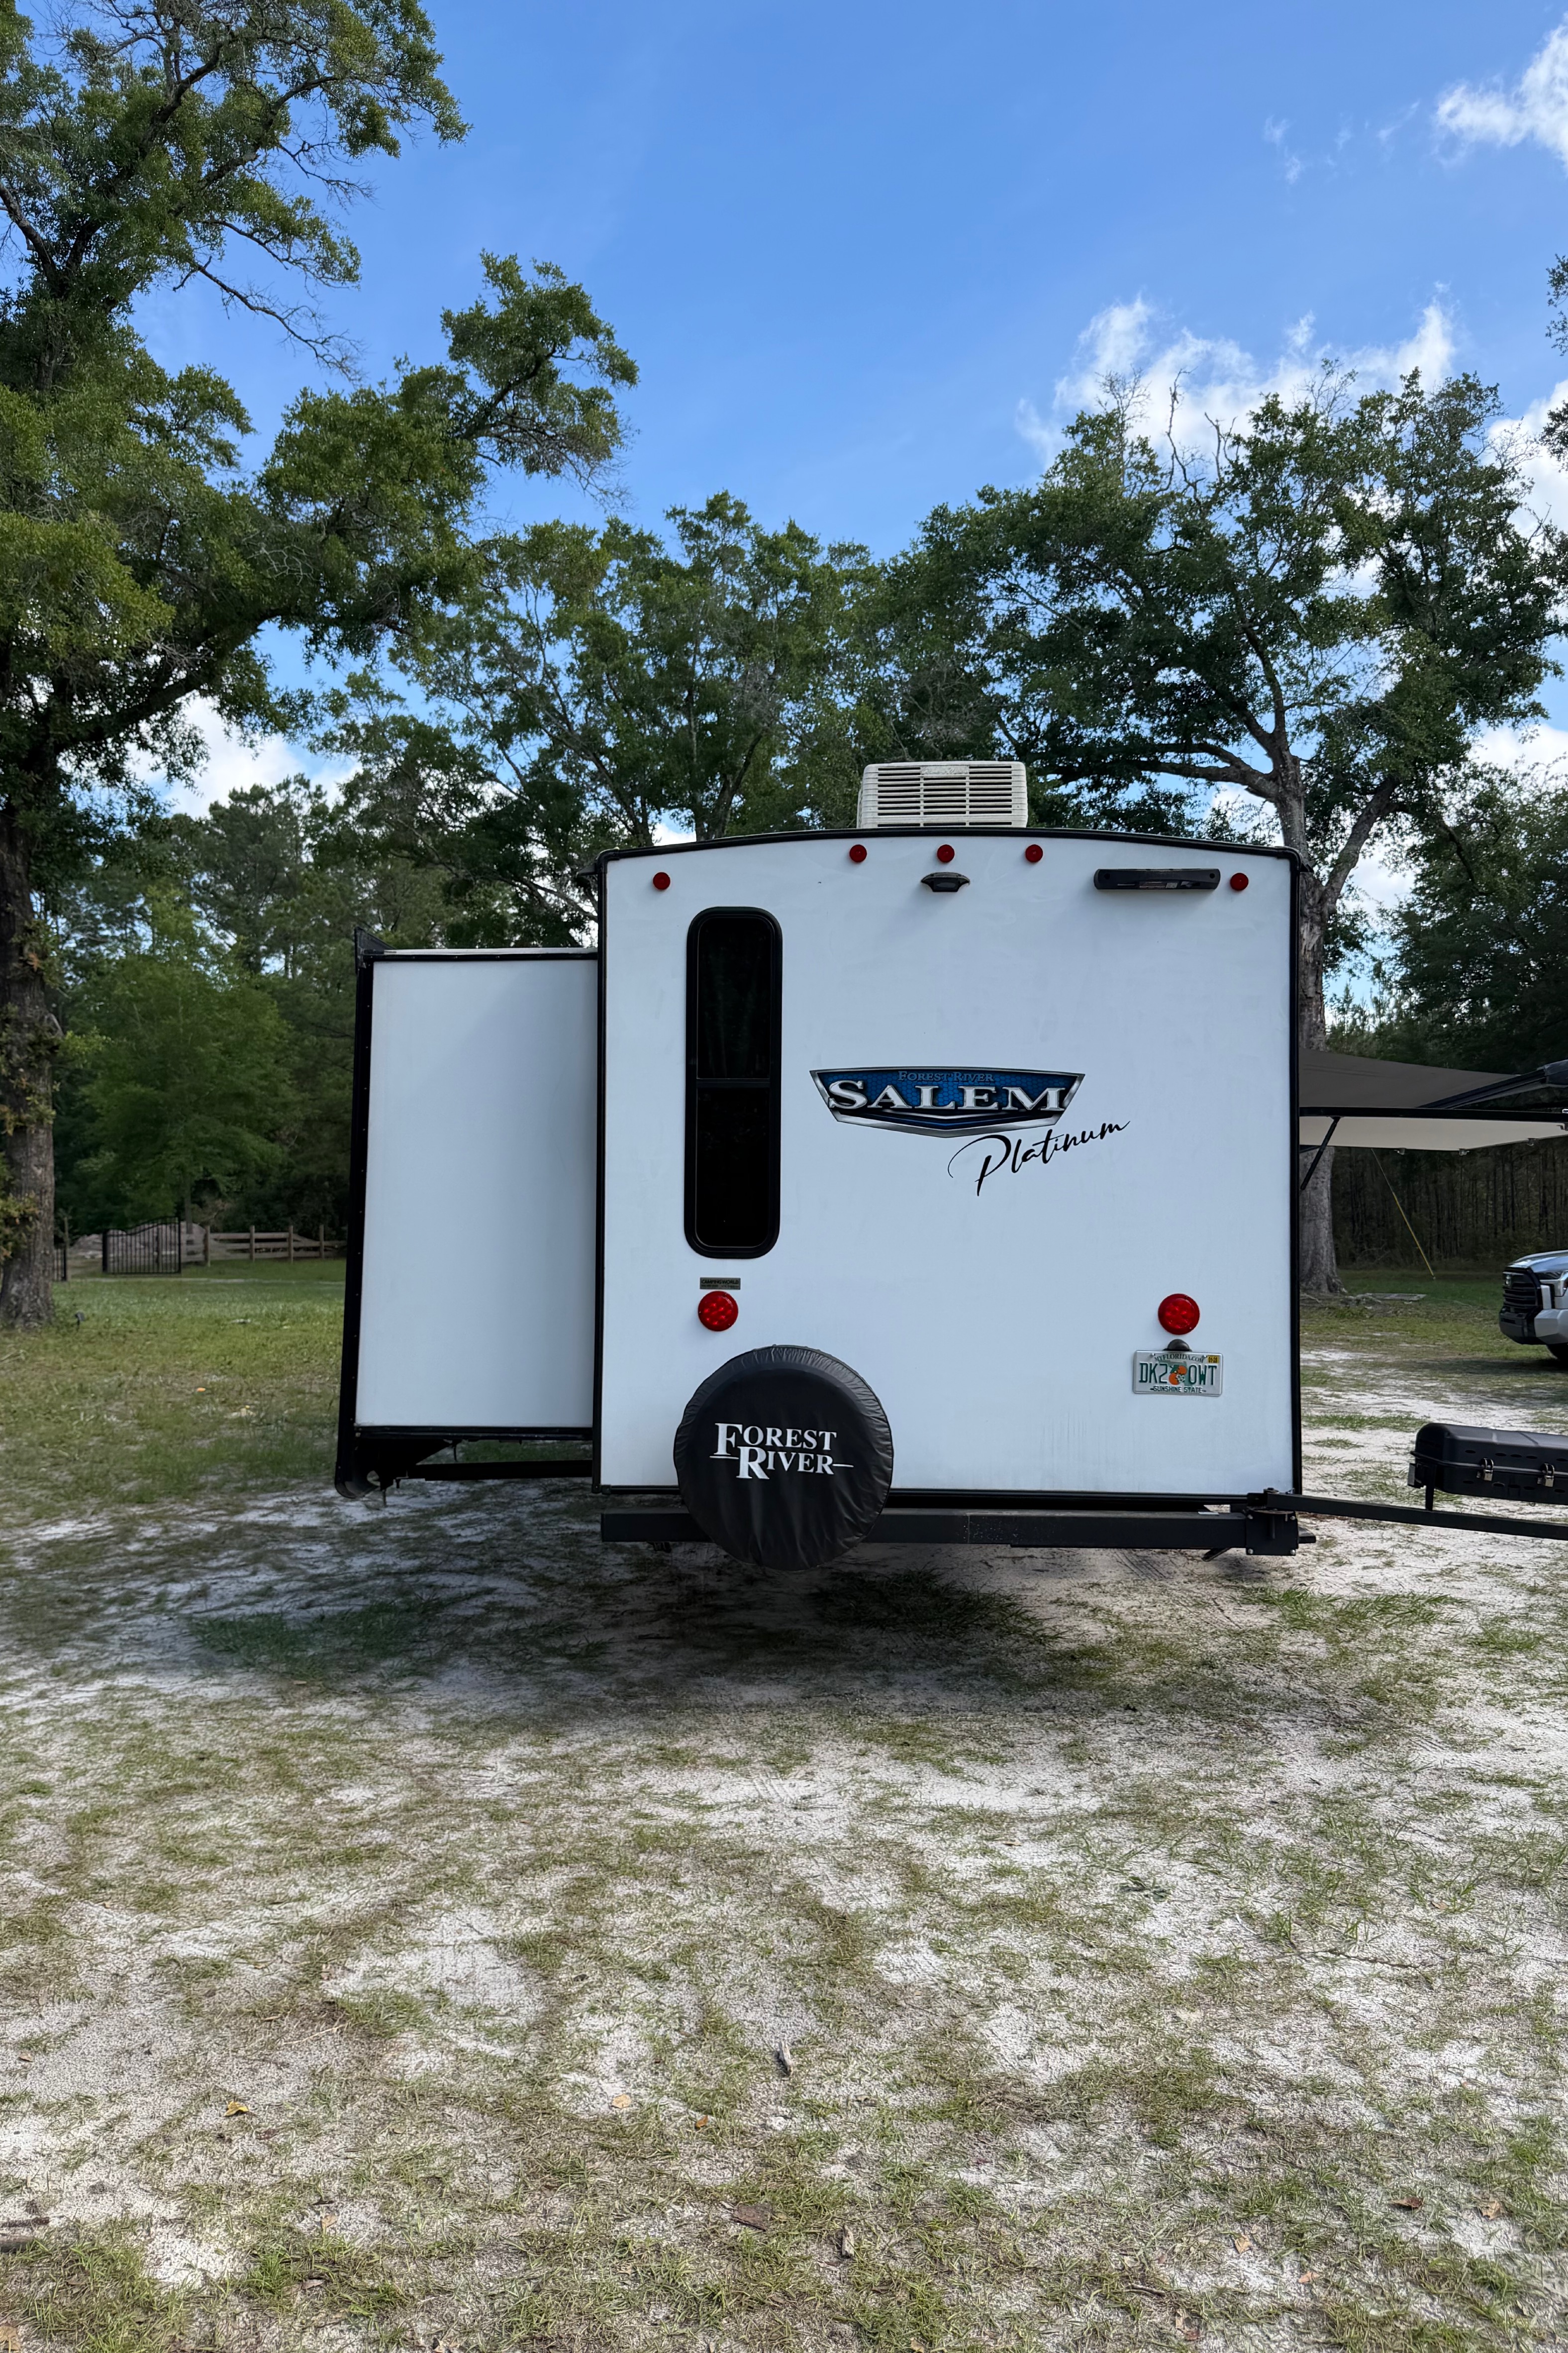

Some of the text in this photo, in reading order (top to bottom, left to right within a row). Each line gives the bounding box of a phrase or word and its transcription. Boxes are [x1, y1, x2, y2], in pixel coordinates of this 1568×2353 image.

[898, 1071, 995, 1082] FOREST RIVER
[828, 1079, 1068, 1111] SALEM
[947, 1120, 1131, 1196] Platinum
[1139, 1362, 1168, 1384] DK2
[713, 1423, 837, 1456] FOREST
[736, 1446, 835, 1480] RIVER
